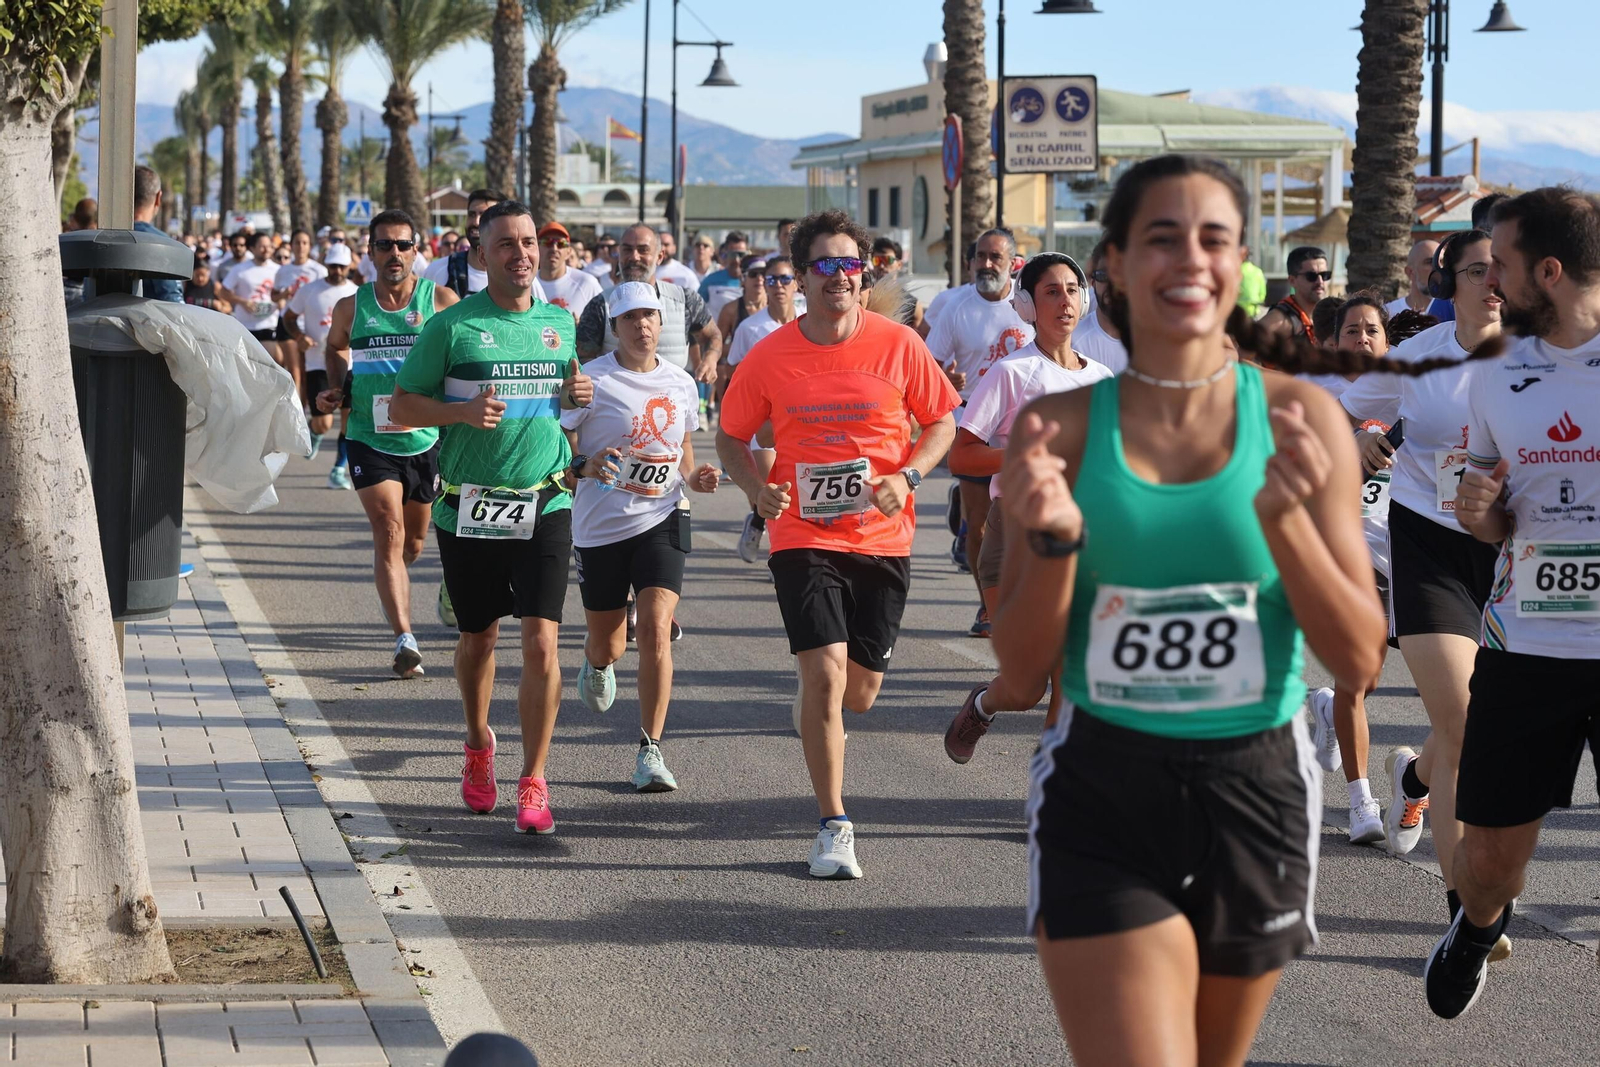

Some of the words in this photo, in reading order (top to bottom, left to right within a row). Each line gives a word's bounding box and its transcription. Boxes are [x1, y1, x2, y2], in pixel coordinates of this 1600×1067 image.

[1016, 144, 1033, 153] EN
[1038, 143, 1085, 152] CARRIL
[1010, 155, 1092, 166] SEÑALIZADO
[491, 363, 557, 377] ATLETISMO
[786, 406, 797, 414] VII
[799, 403, 842, 413] TRAVESÍA
[845, 402, 852, 410] A
[853, 402, 879, 410] NADO
[824, 435, 846, 443] 2024
[629, 462, 670, 484] 108
[809, 474, 862, 501] 756
[1363, 482, 1382, 504] 3
[471, 500, 526, 524] 674
[1536, 562, 1600, 592] 685
[1522, 602, 1539, 610] 024
[1113, 617, 1238, 672] 688
